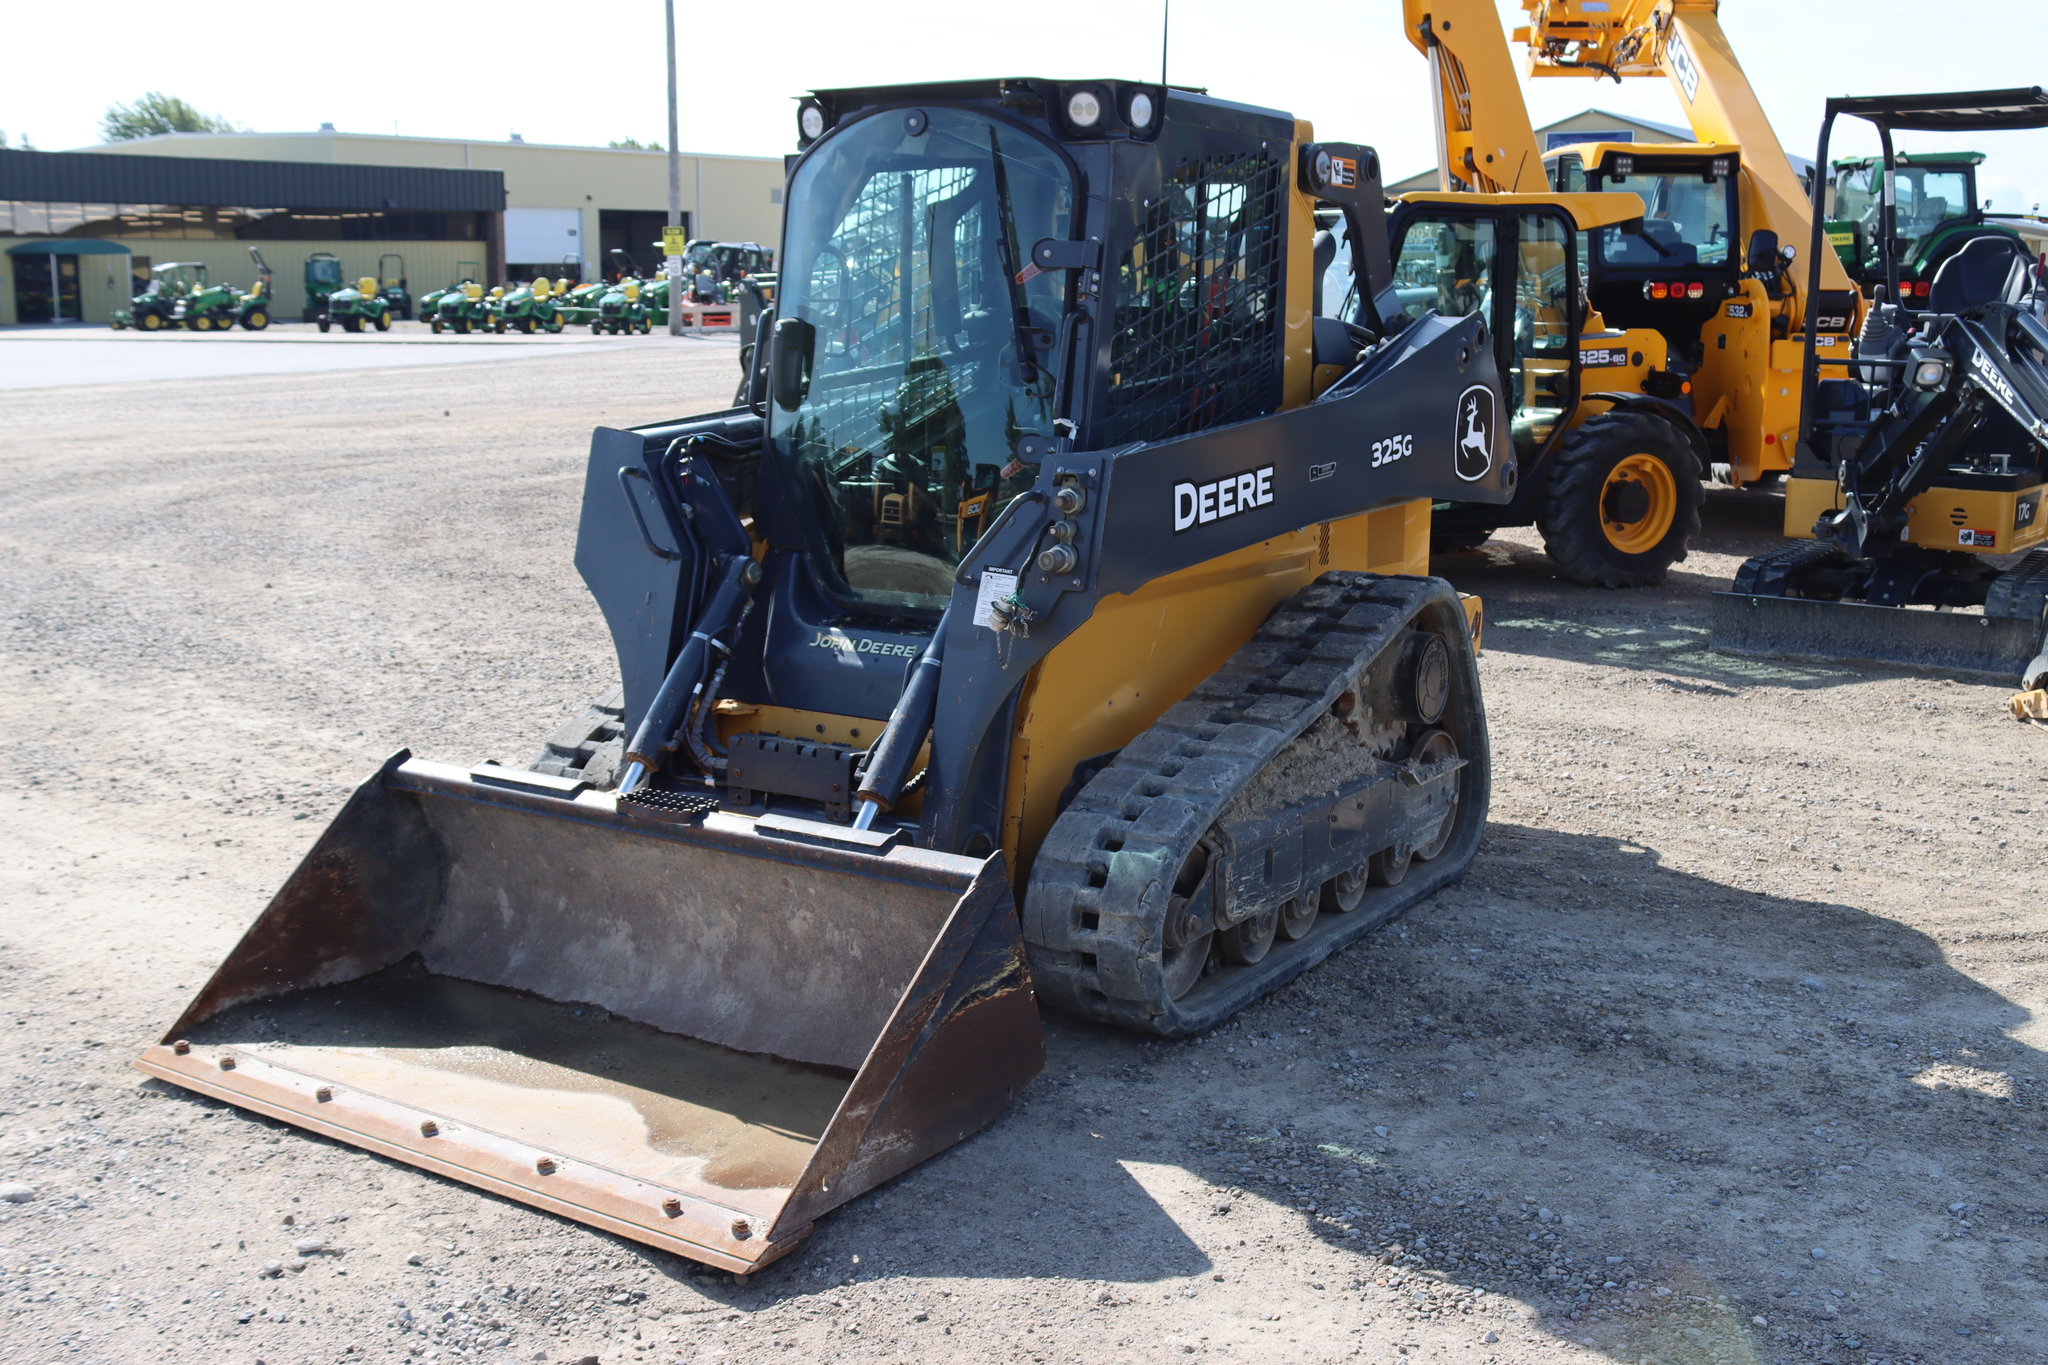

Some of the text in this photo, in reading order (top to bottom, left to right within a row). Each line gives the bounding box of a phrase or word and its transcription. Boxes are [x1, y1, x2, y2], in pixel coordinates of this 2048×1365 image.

[1666, 32, 1699, 103] JCB
[1803, 316, 1846, 328] CB
[1815, 336, 1836, 346] CB
[1971, 347, 2014, 405] DEERE
[1371, 434, 1413, 468] 325G
[1174, 466, 1274, 532] DEERE
[2017, 502, 2031, 521] 17G
[988, 567, 1014, 575] IMPORTANT
[809, 631, 919, 658] JOHN DEERE
